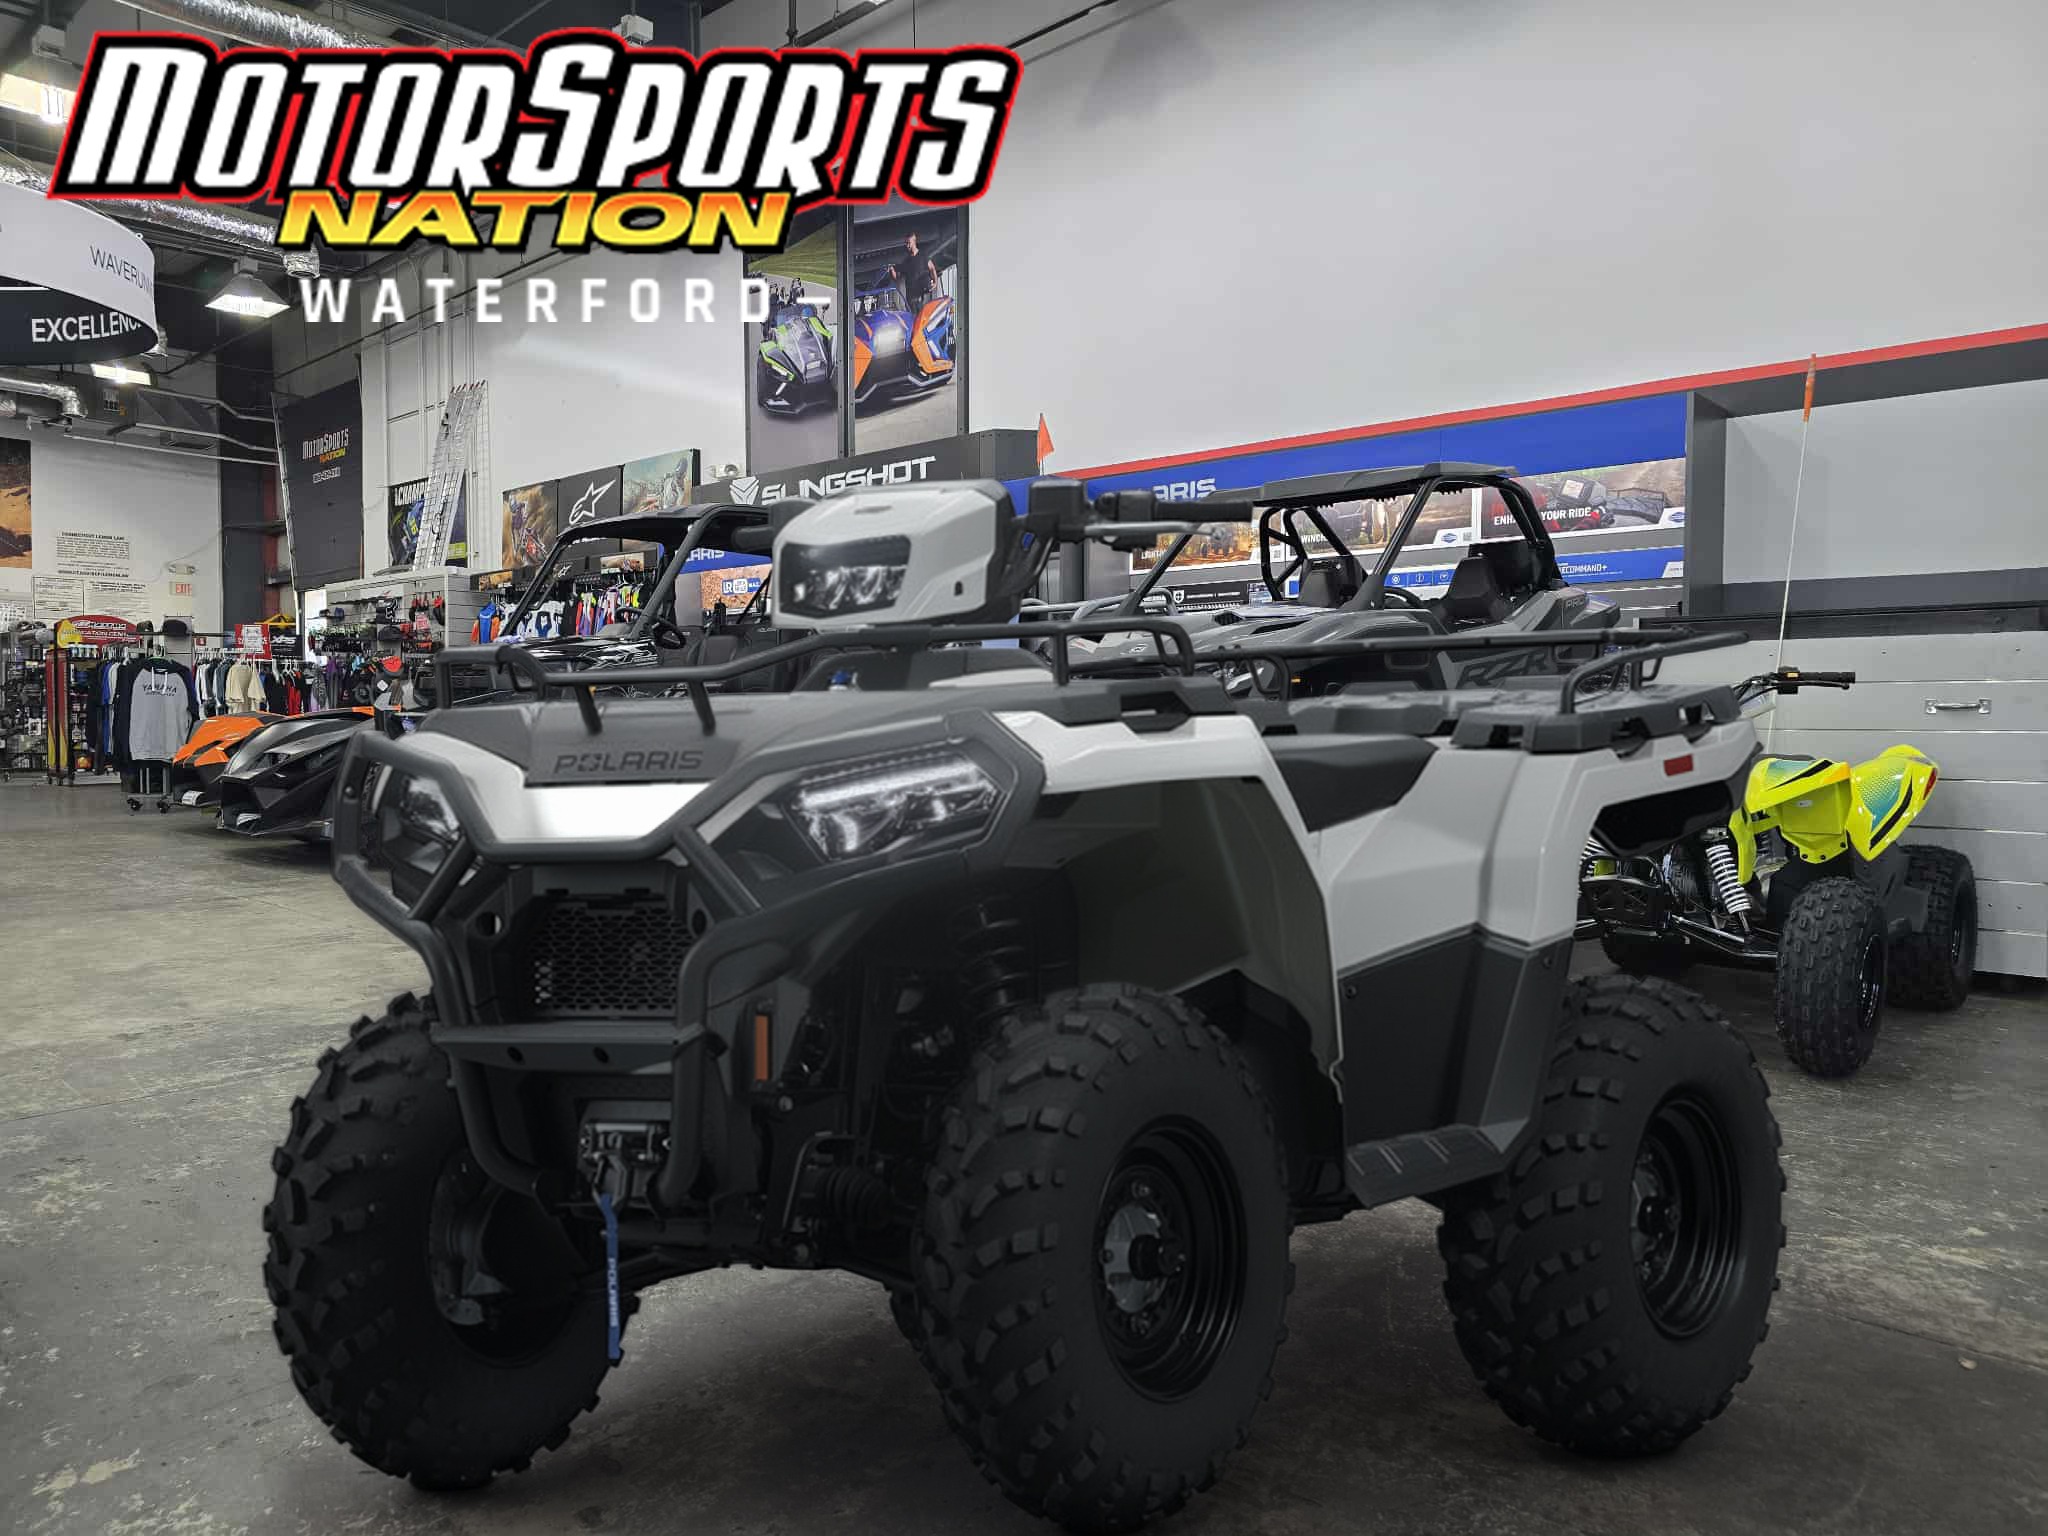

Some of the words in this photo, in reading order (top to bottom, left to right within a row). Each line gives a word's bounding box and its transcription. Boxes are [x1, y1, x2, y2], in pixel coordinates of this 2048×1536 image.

[1541, 510, 1567, 521] YOUR
[1568, 507, 1592, 518] RIDE
[175, 583, 192, 596] EXIT
[553, 750, 703, 775] POLARIS
